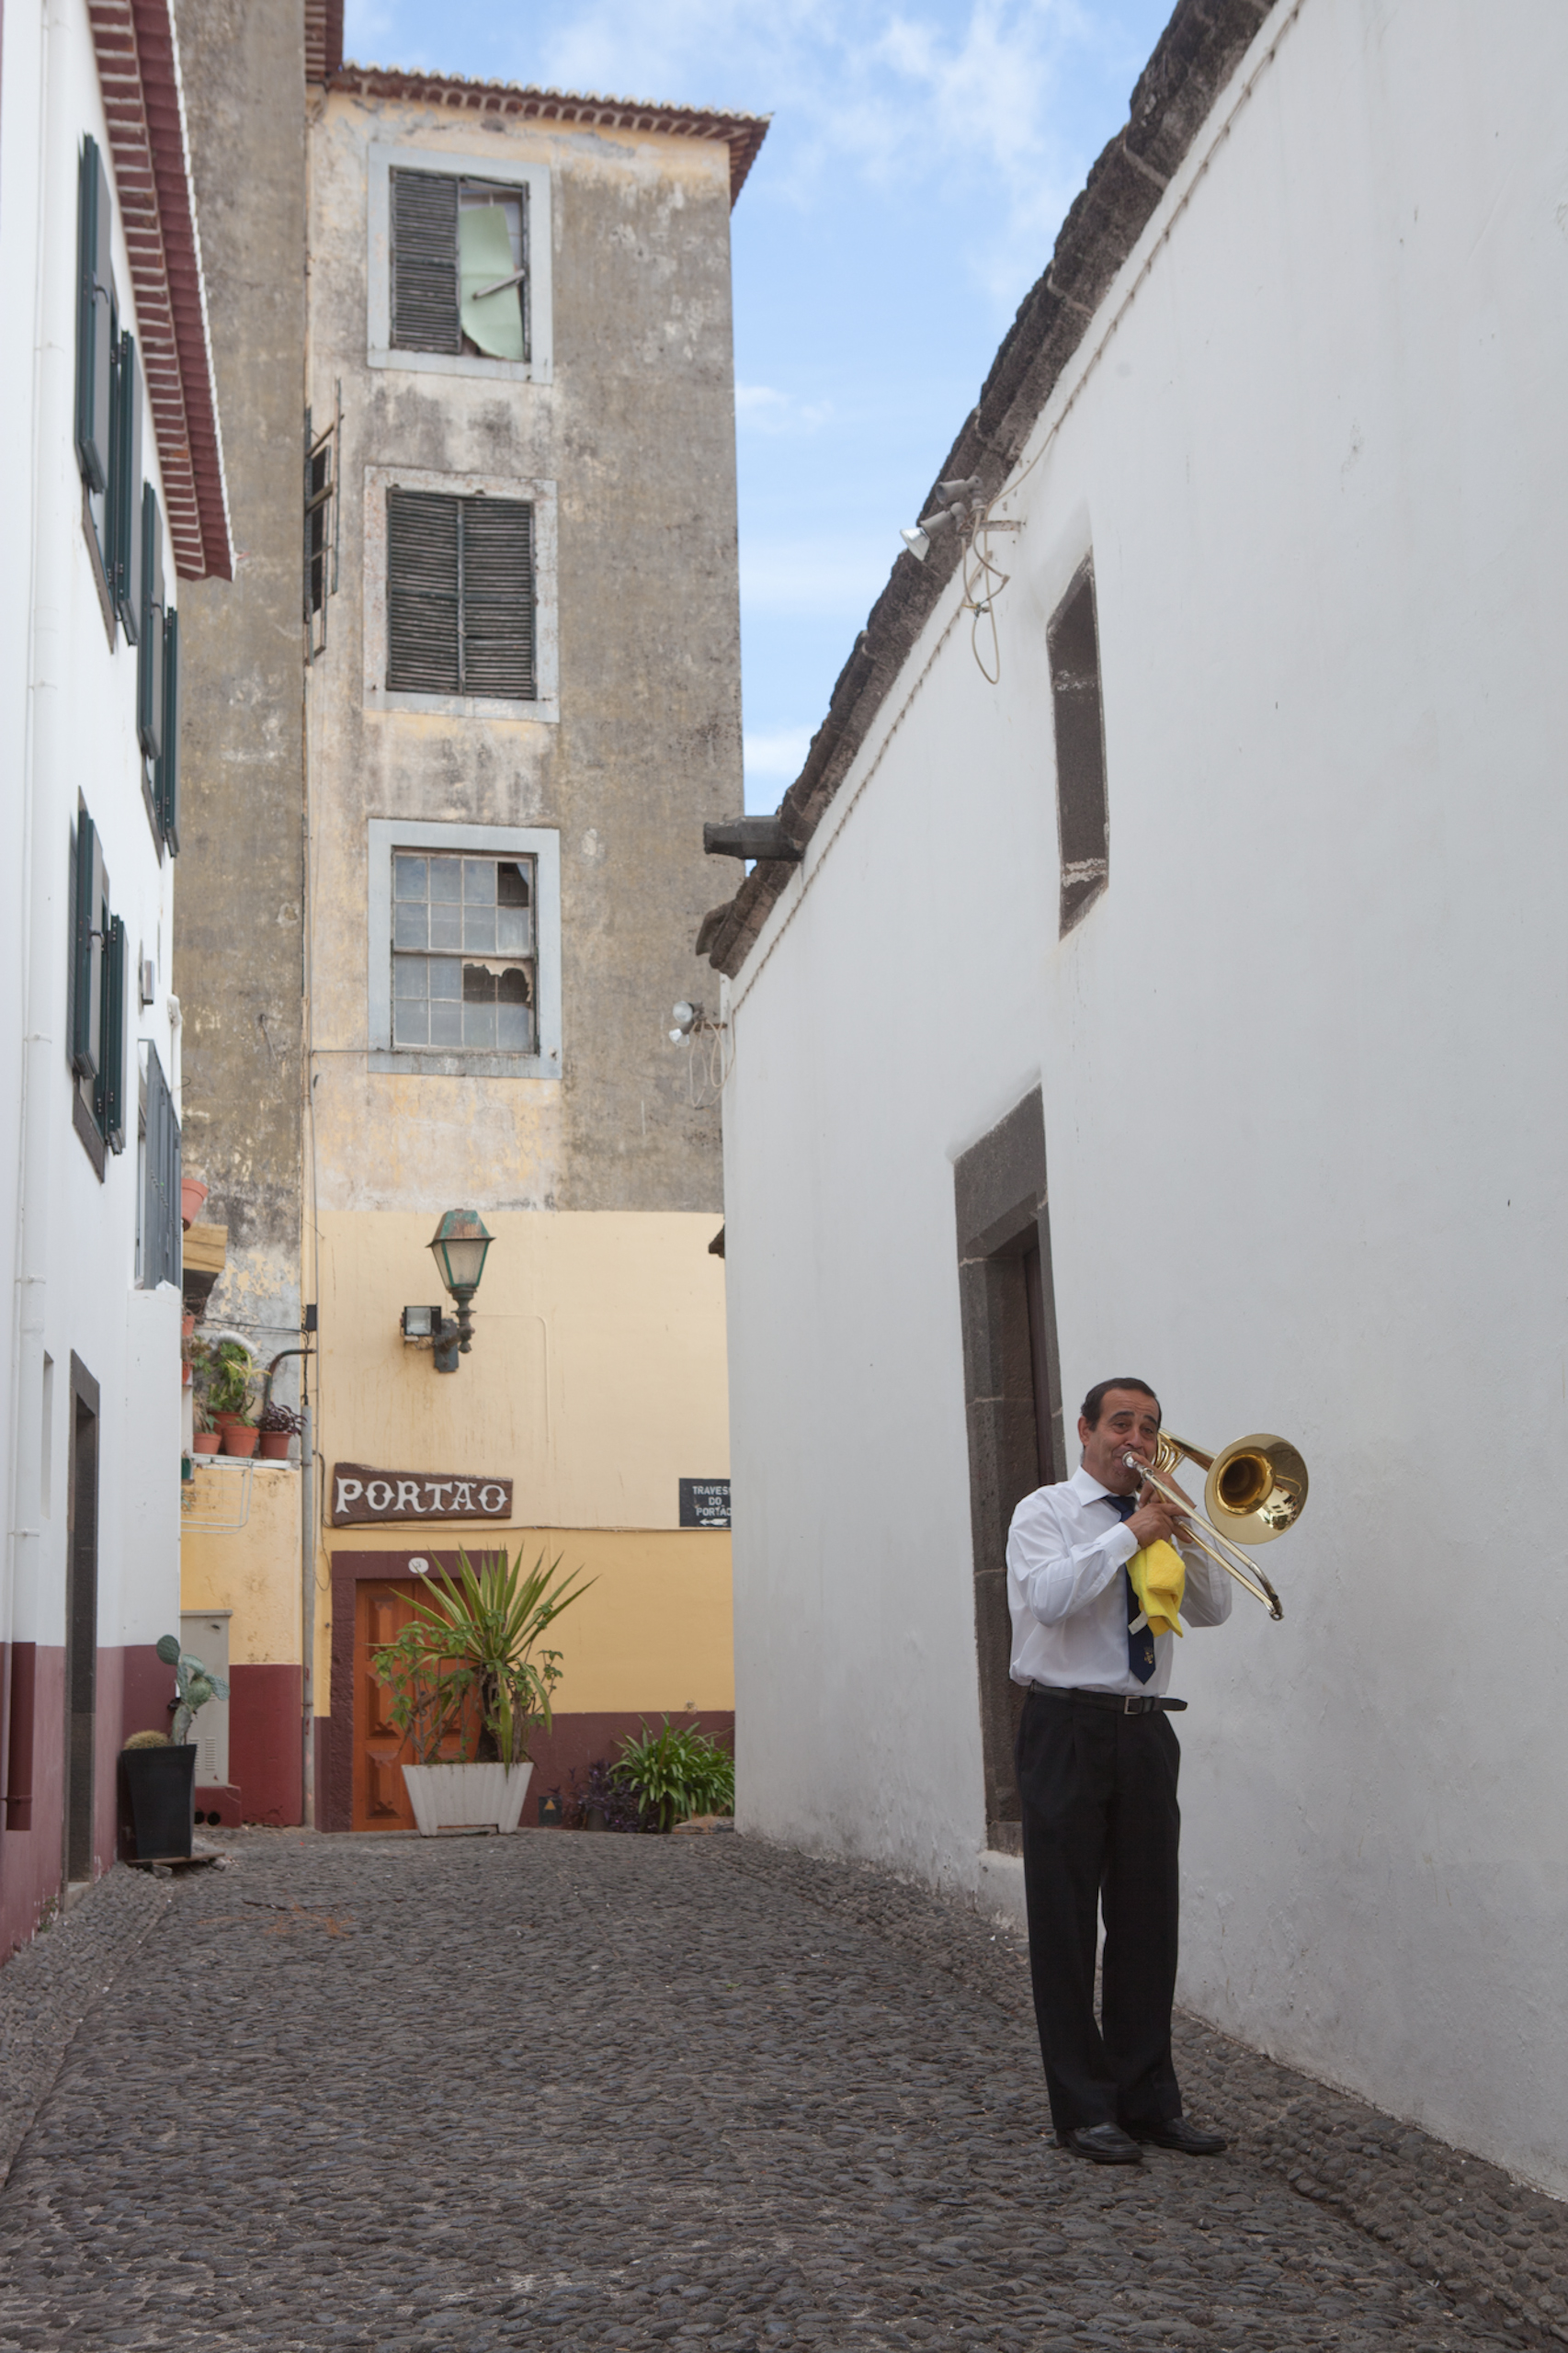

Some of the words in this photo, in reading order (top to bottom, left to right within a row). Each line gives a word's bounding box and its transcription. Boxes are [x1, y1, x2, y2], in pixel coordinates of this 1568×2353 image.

[335, 1476, 508, 1513] PORTÃO
[692, 1485, 731, 1495] TRAVES
[709, 1496, 722, 1506] DO
